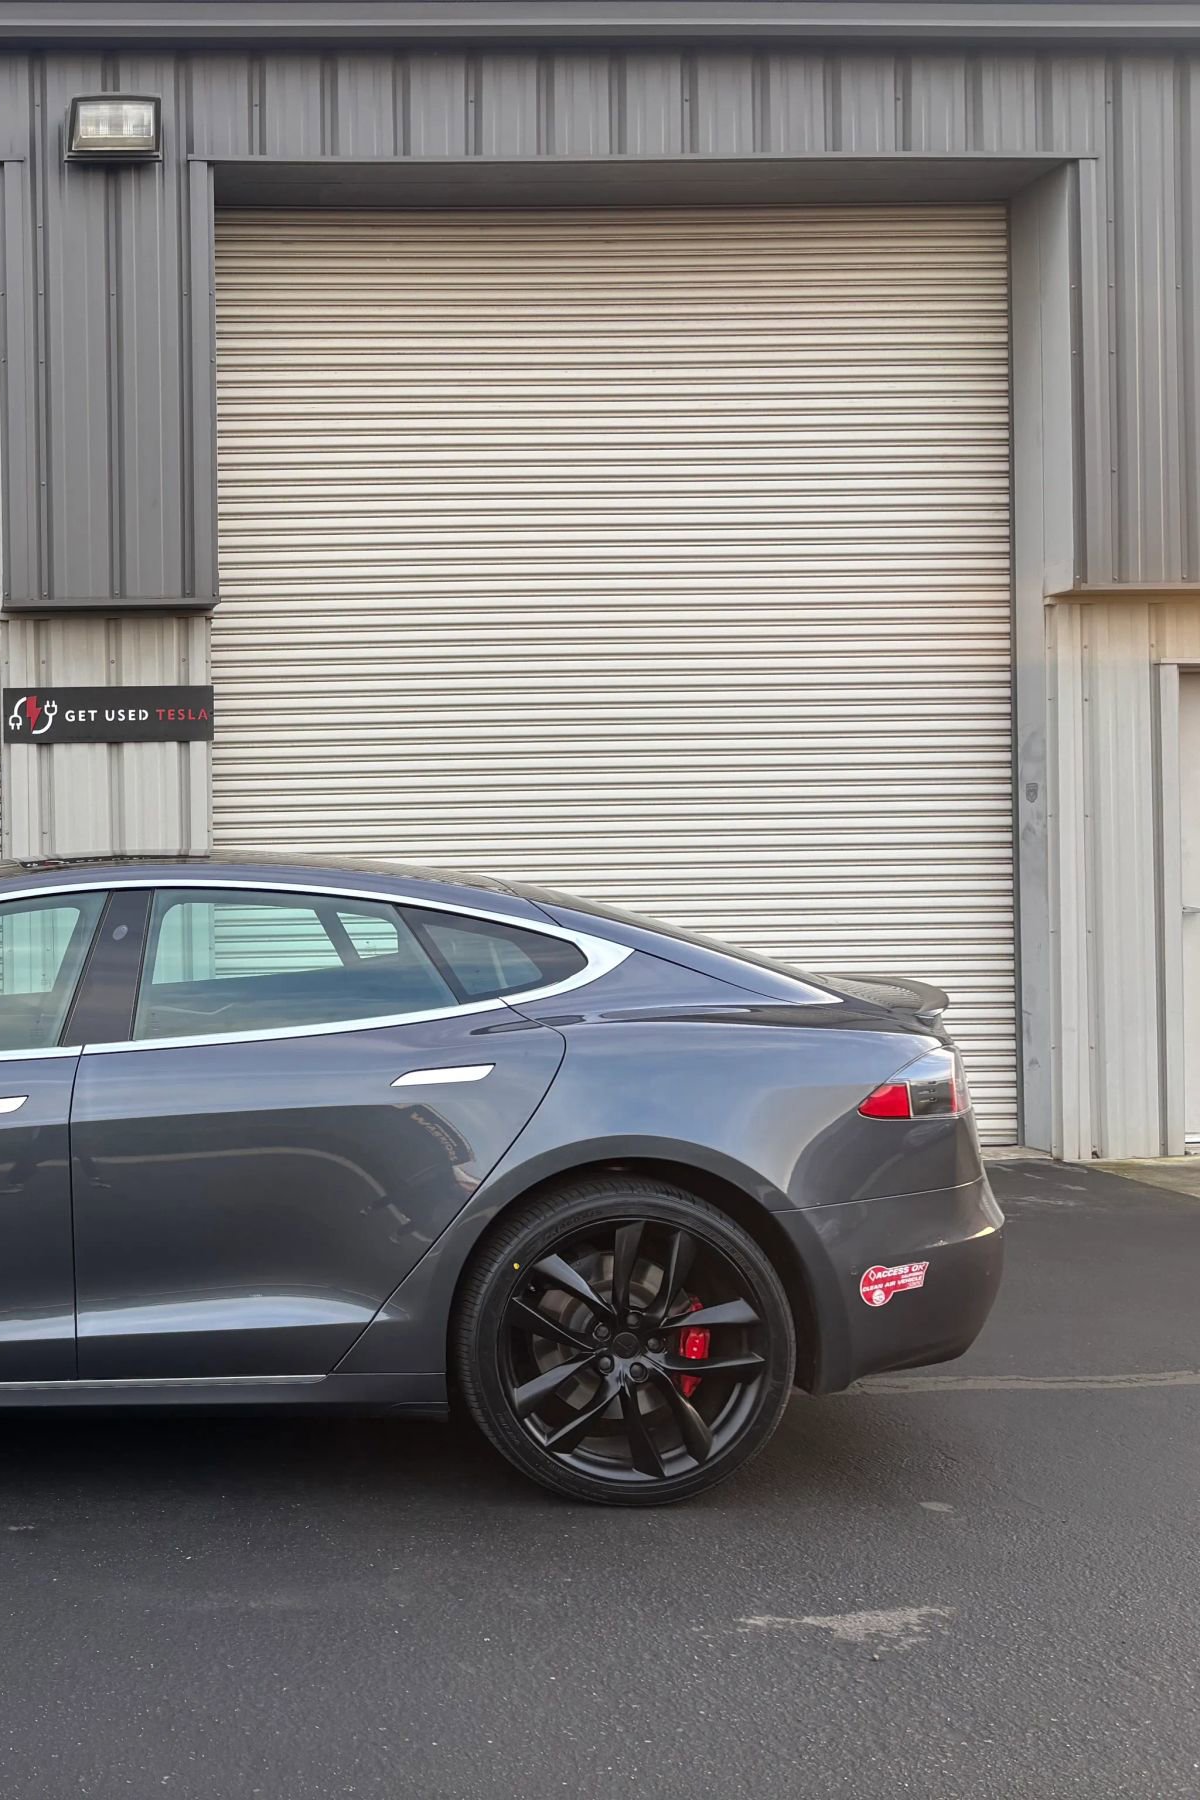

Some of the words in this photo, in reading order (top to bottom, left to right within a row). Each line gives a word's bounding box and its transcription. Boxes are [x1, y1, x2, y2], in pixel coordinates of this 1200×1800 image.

[64, 709, 98, 722] GET
[104, 708, 149, 722] USED
[155, 708, 209, 721] TESLA
[875, 1266, 910, 1279] ACCESS
[911, 1264, 925, 1272] OK
[862, 1283, 883, 1292] CLEAN
[884, 1280, 896, 1288] AIR
